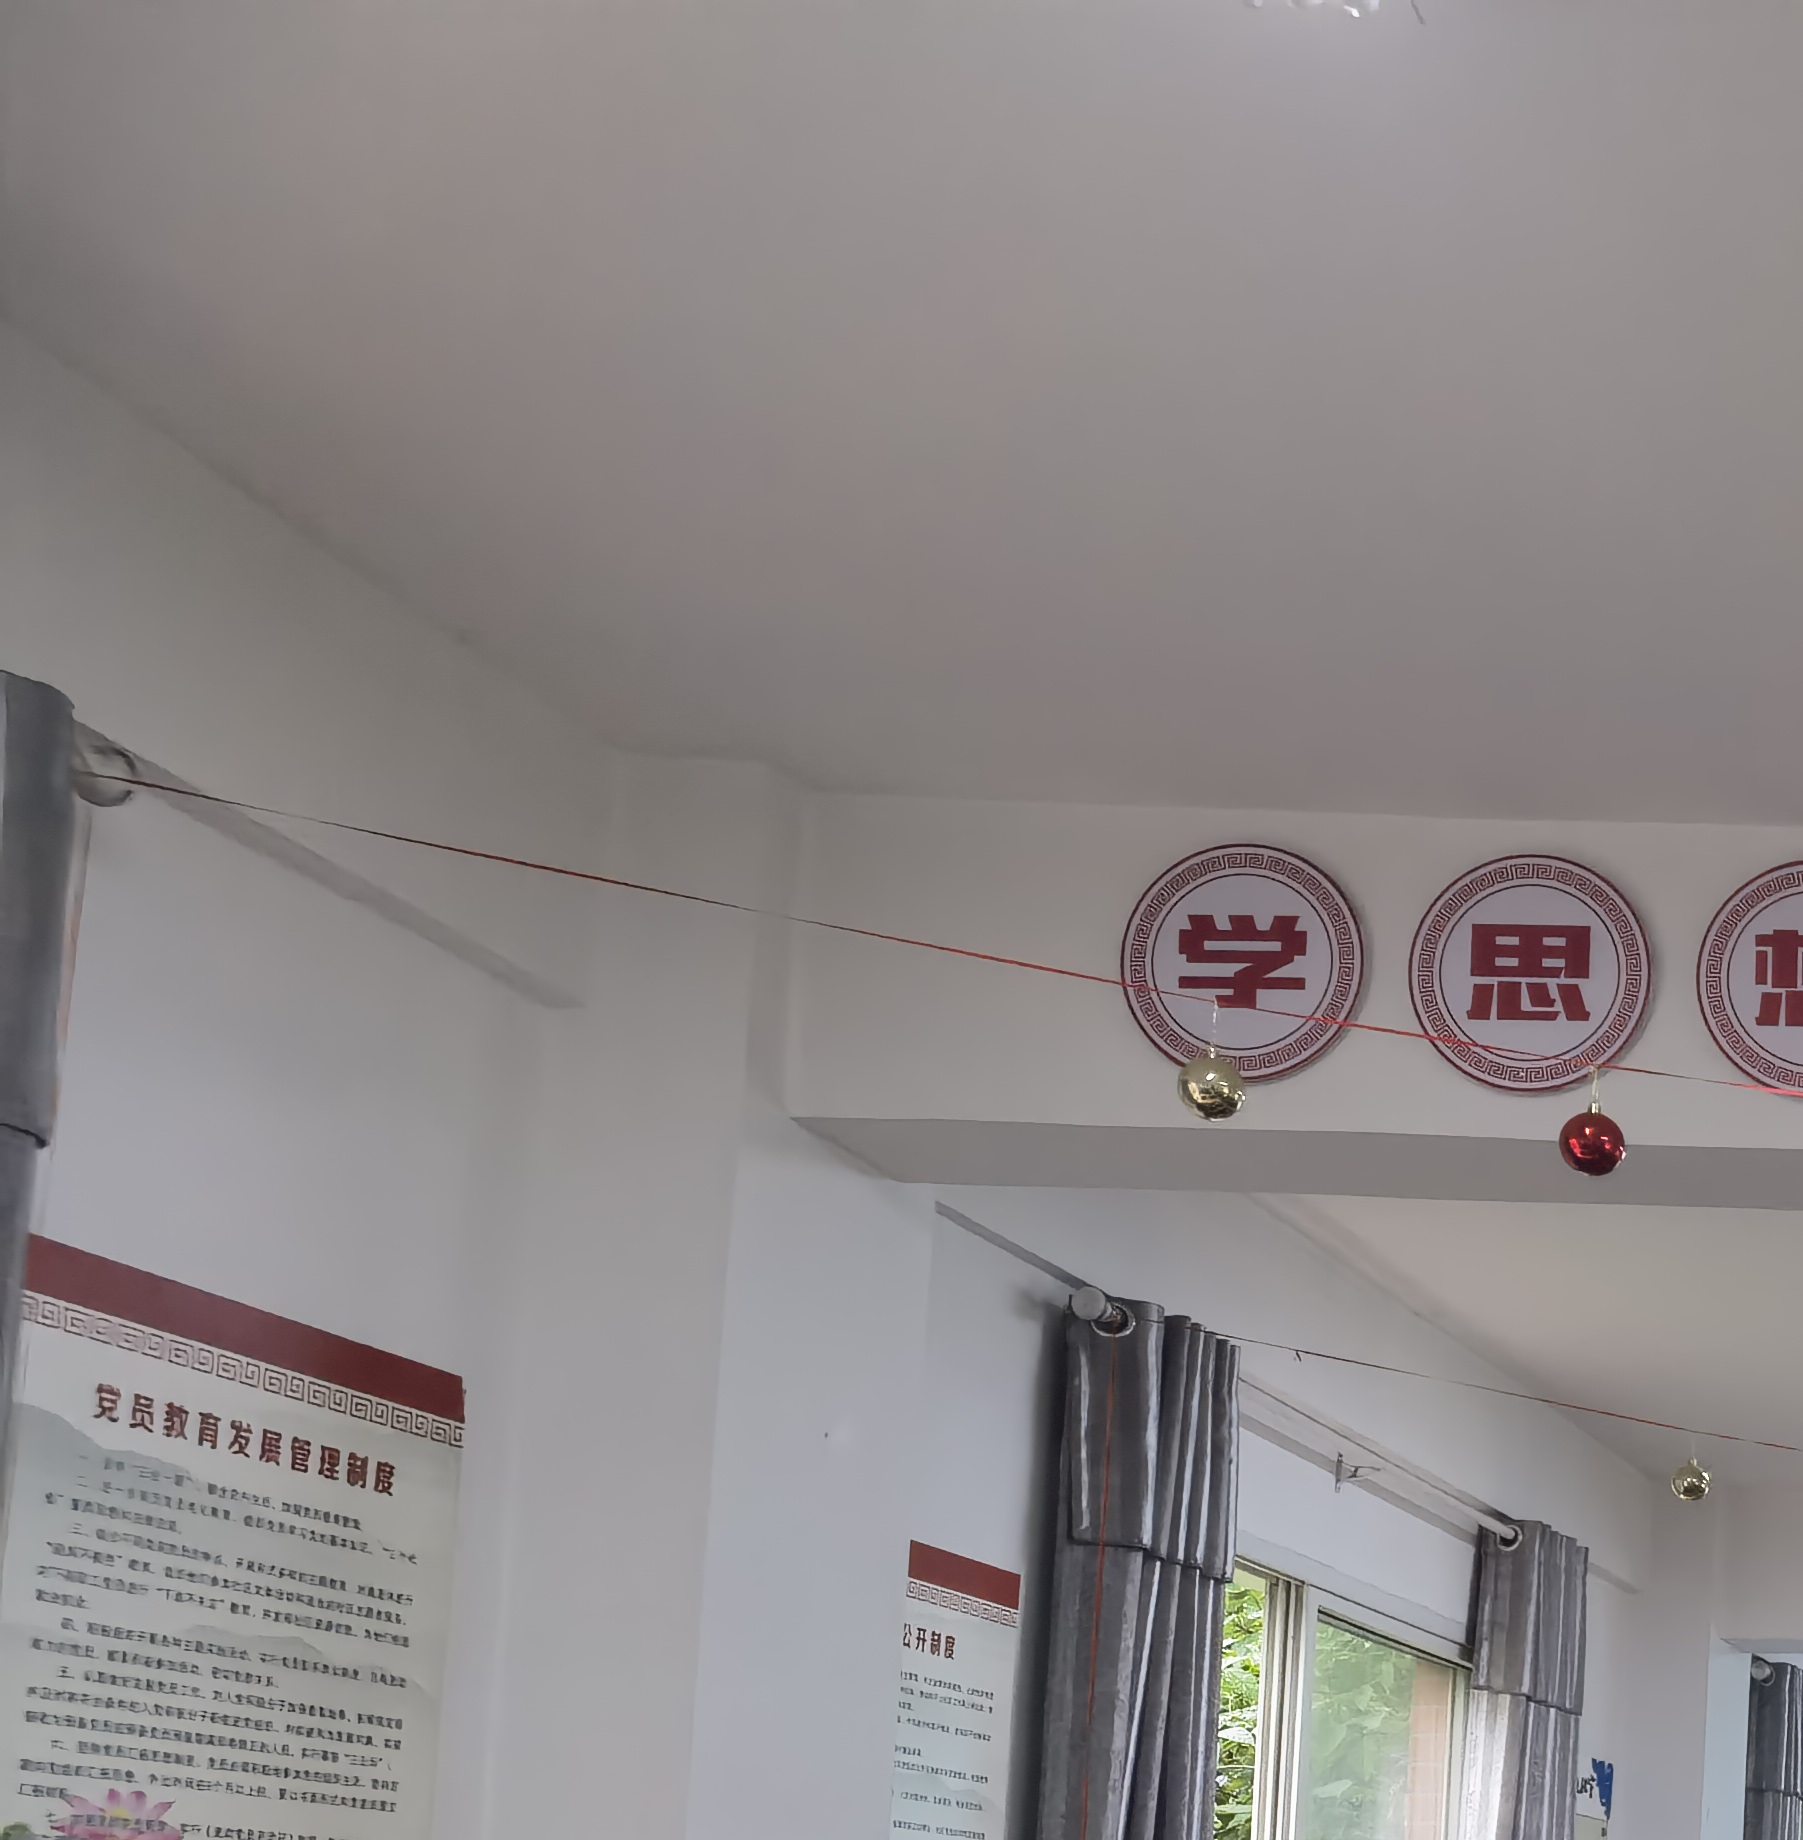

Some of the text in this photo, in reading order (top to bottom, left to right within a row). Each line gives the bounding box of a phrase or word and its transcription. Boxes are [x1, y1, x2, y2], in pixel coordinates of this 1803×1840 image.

[93, 1383, 395, 1497] 党员教育发展管理制度
